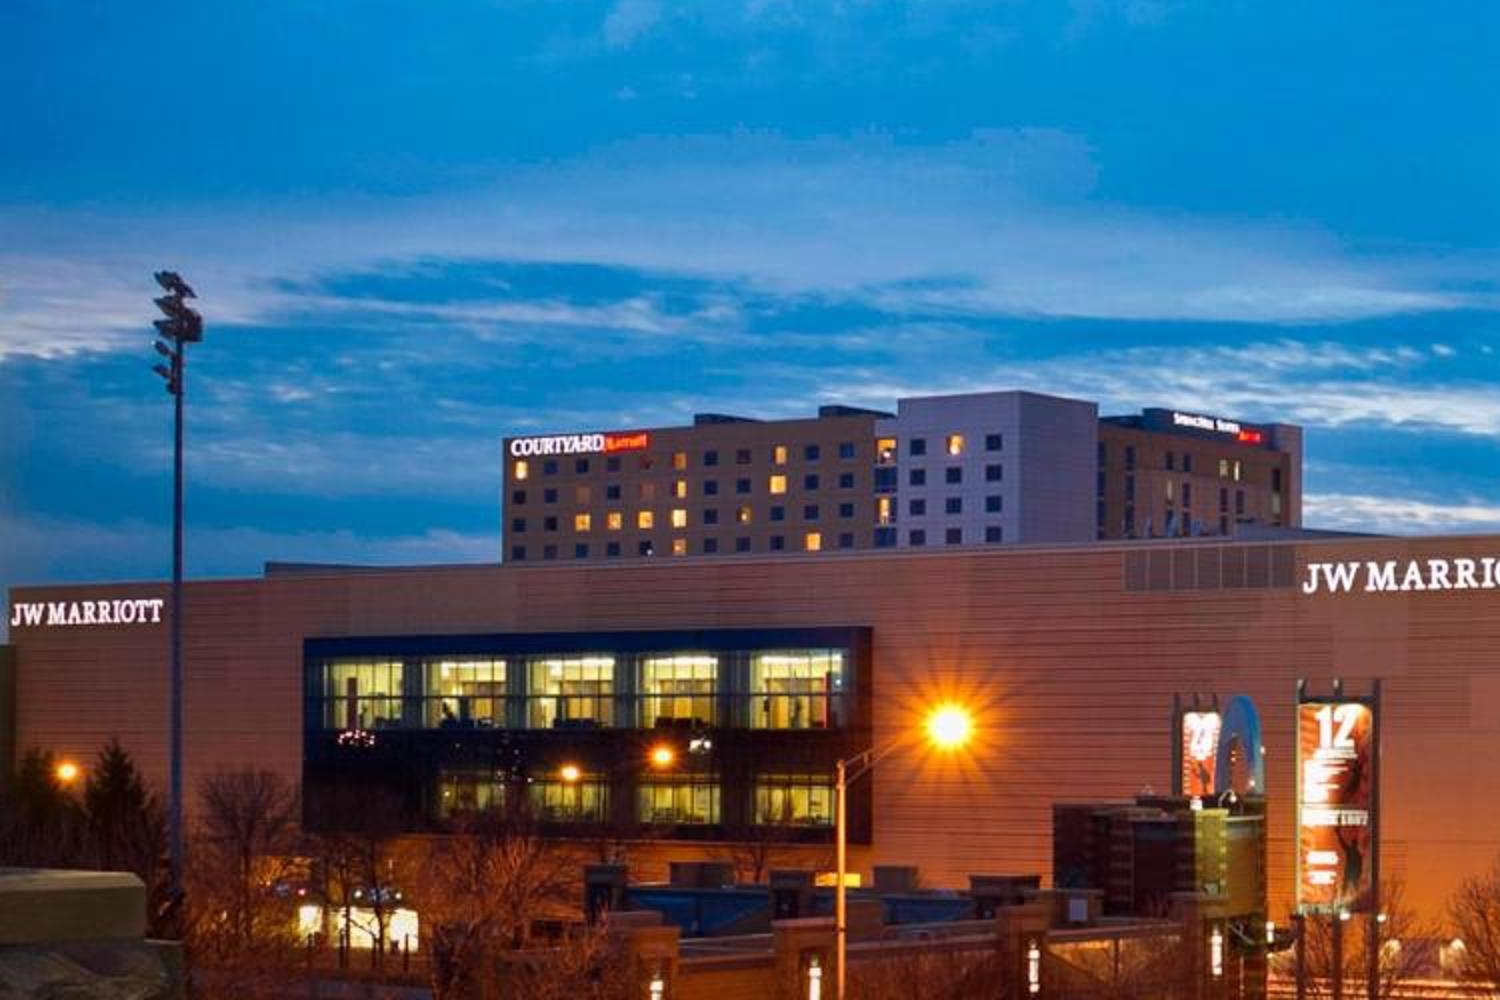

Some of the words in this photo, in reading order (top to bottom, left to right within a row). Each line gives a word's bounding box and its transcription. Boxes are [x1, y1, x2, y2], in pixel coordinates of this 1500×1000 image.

[510, 434, 605, 456] COURTYARD
[1302, 563, 1360, 594] JW
[11, 602, 45, 627] JW
[47, 599, 164, 626] MARRIOTT
